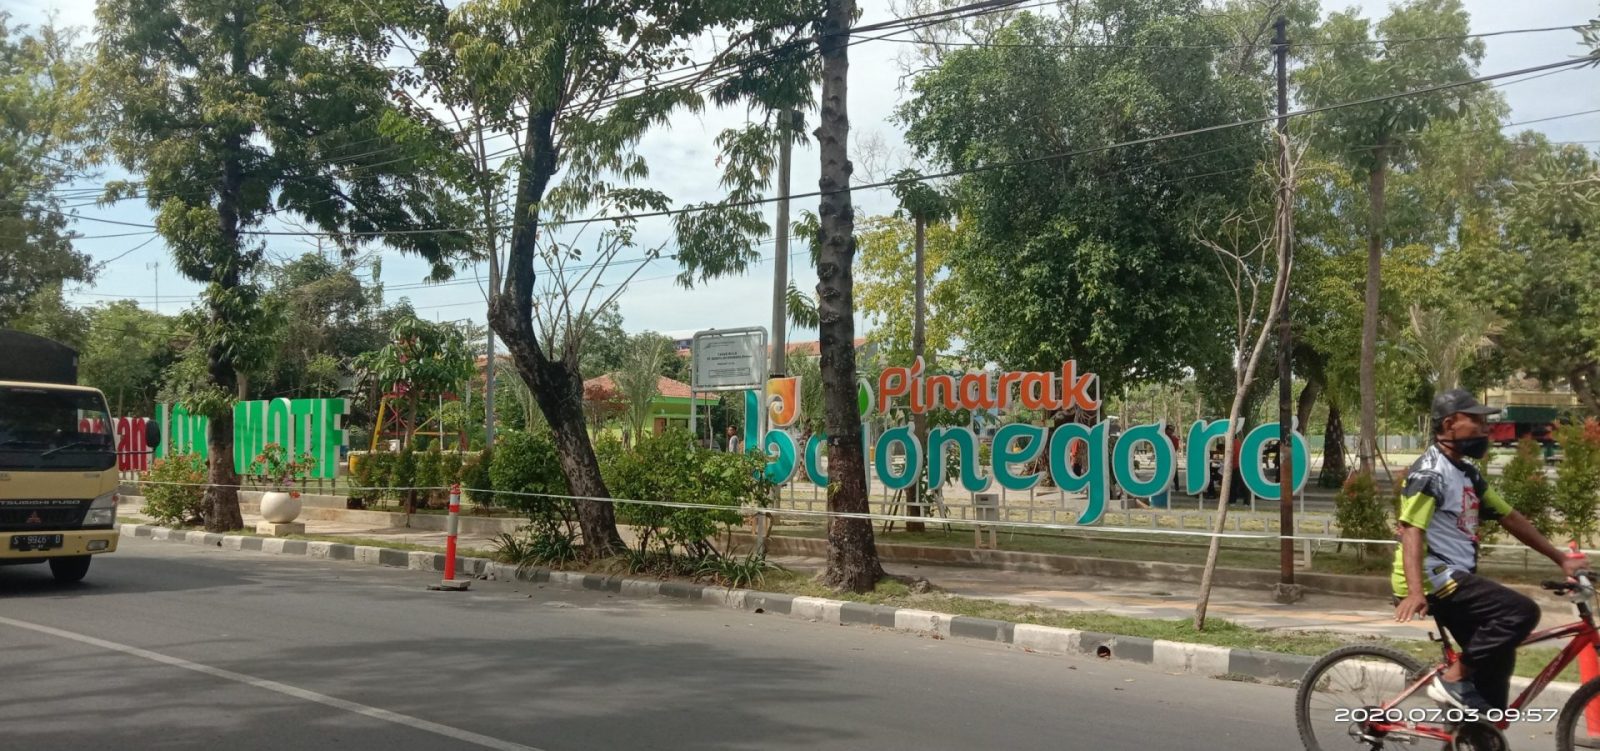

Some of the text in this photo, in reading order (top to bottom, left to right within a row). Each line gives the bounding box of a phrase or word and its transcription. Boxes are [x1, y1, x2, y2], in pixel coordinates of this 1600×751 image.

[878, 357, 1101, 415] Pinarak
[155, 398, 348, 480] LOKMOTIF
[743, 388, 1309, 525] boonegoro
